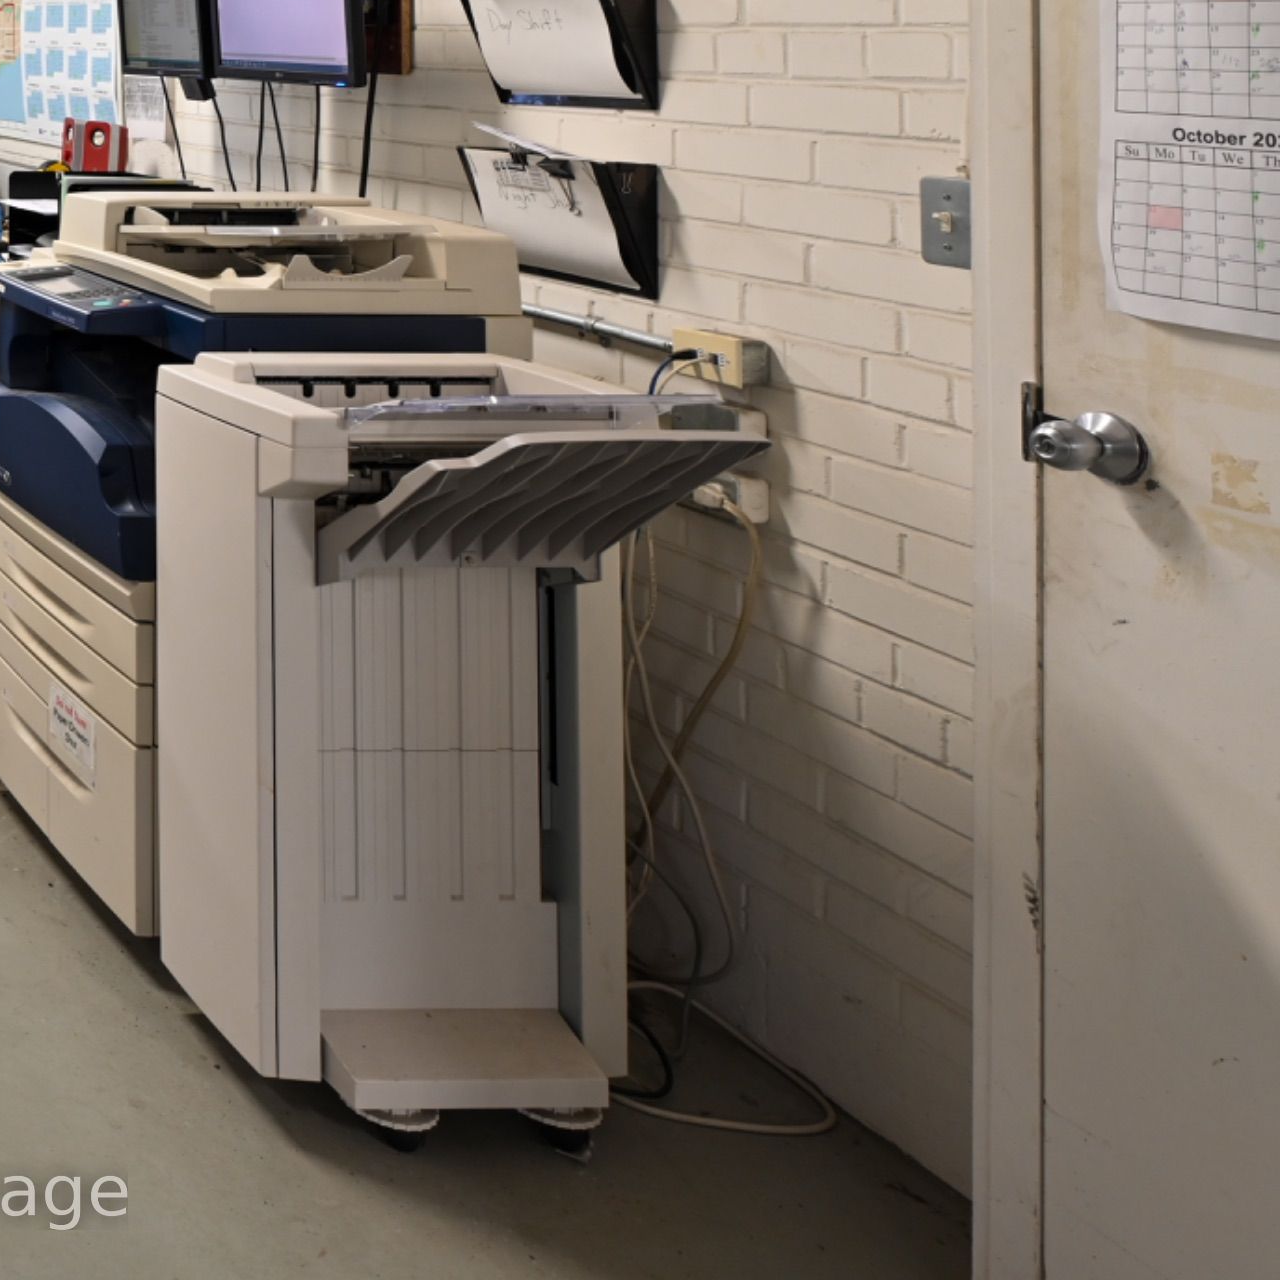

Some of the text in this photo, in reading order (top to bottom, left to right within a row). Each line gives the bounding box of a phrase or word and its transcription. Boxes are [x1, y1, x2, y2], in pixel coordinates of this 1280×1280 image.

[486, 7, 563, 46] Day Shift
[1172, 127, 1280, 148] October 20
[1124, 145, 1139, 156] Su
[1155, 147, 1175, 159] Mo
[1189, 150, 1206, 162] Tu
[1221, 152, 1244, 164] We
